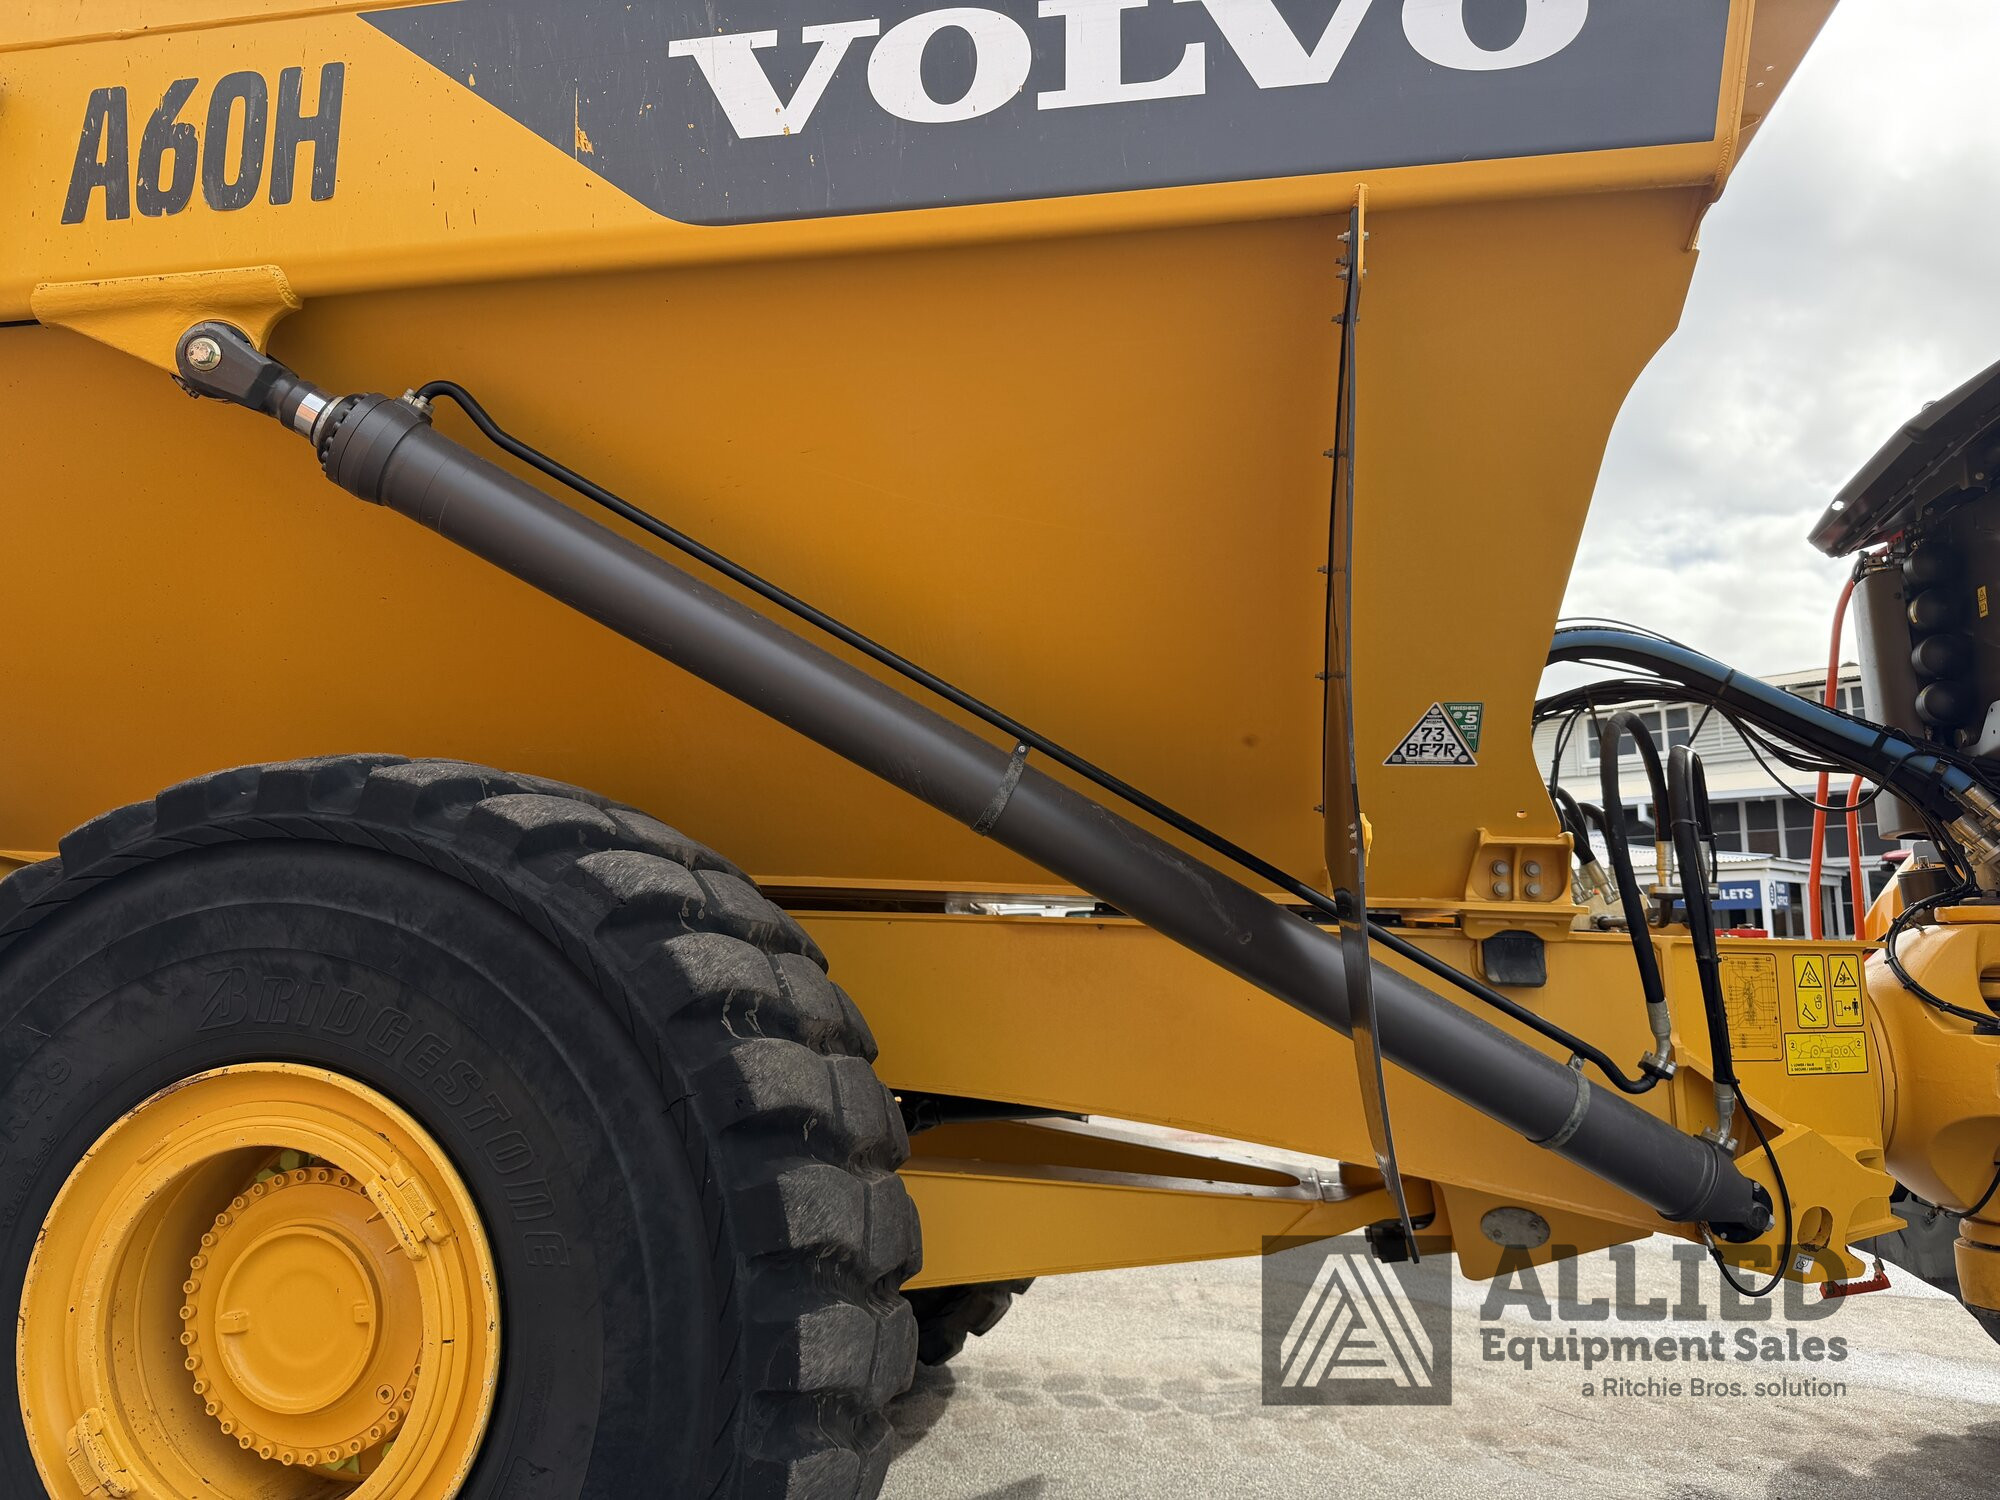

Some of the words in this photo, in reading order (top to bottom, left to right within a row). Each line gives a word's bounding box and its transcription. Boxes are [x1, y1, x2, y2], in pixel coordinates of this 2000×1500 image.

[669, 0, 1588, 139] VOLVO
[60, 61, 346, 226] A60H
[1406, 743, 1456, 758] BF7R
[1421, 727, 1445, 742] 73
[1464, 711, 1478, 724] 5
[196, 966, 571, 1267] BRIDGESTONE
